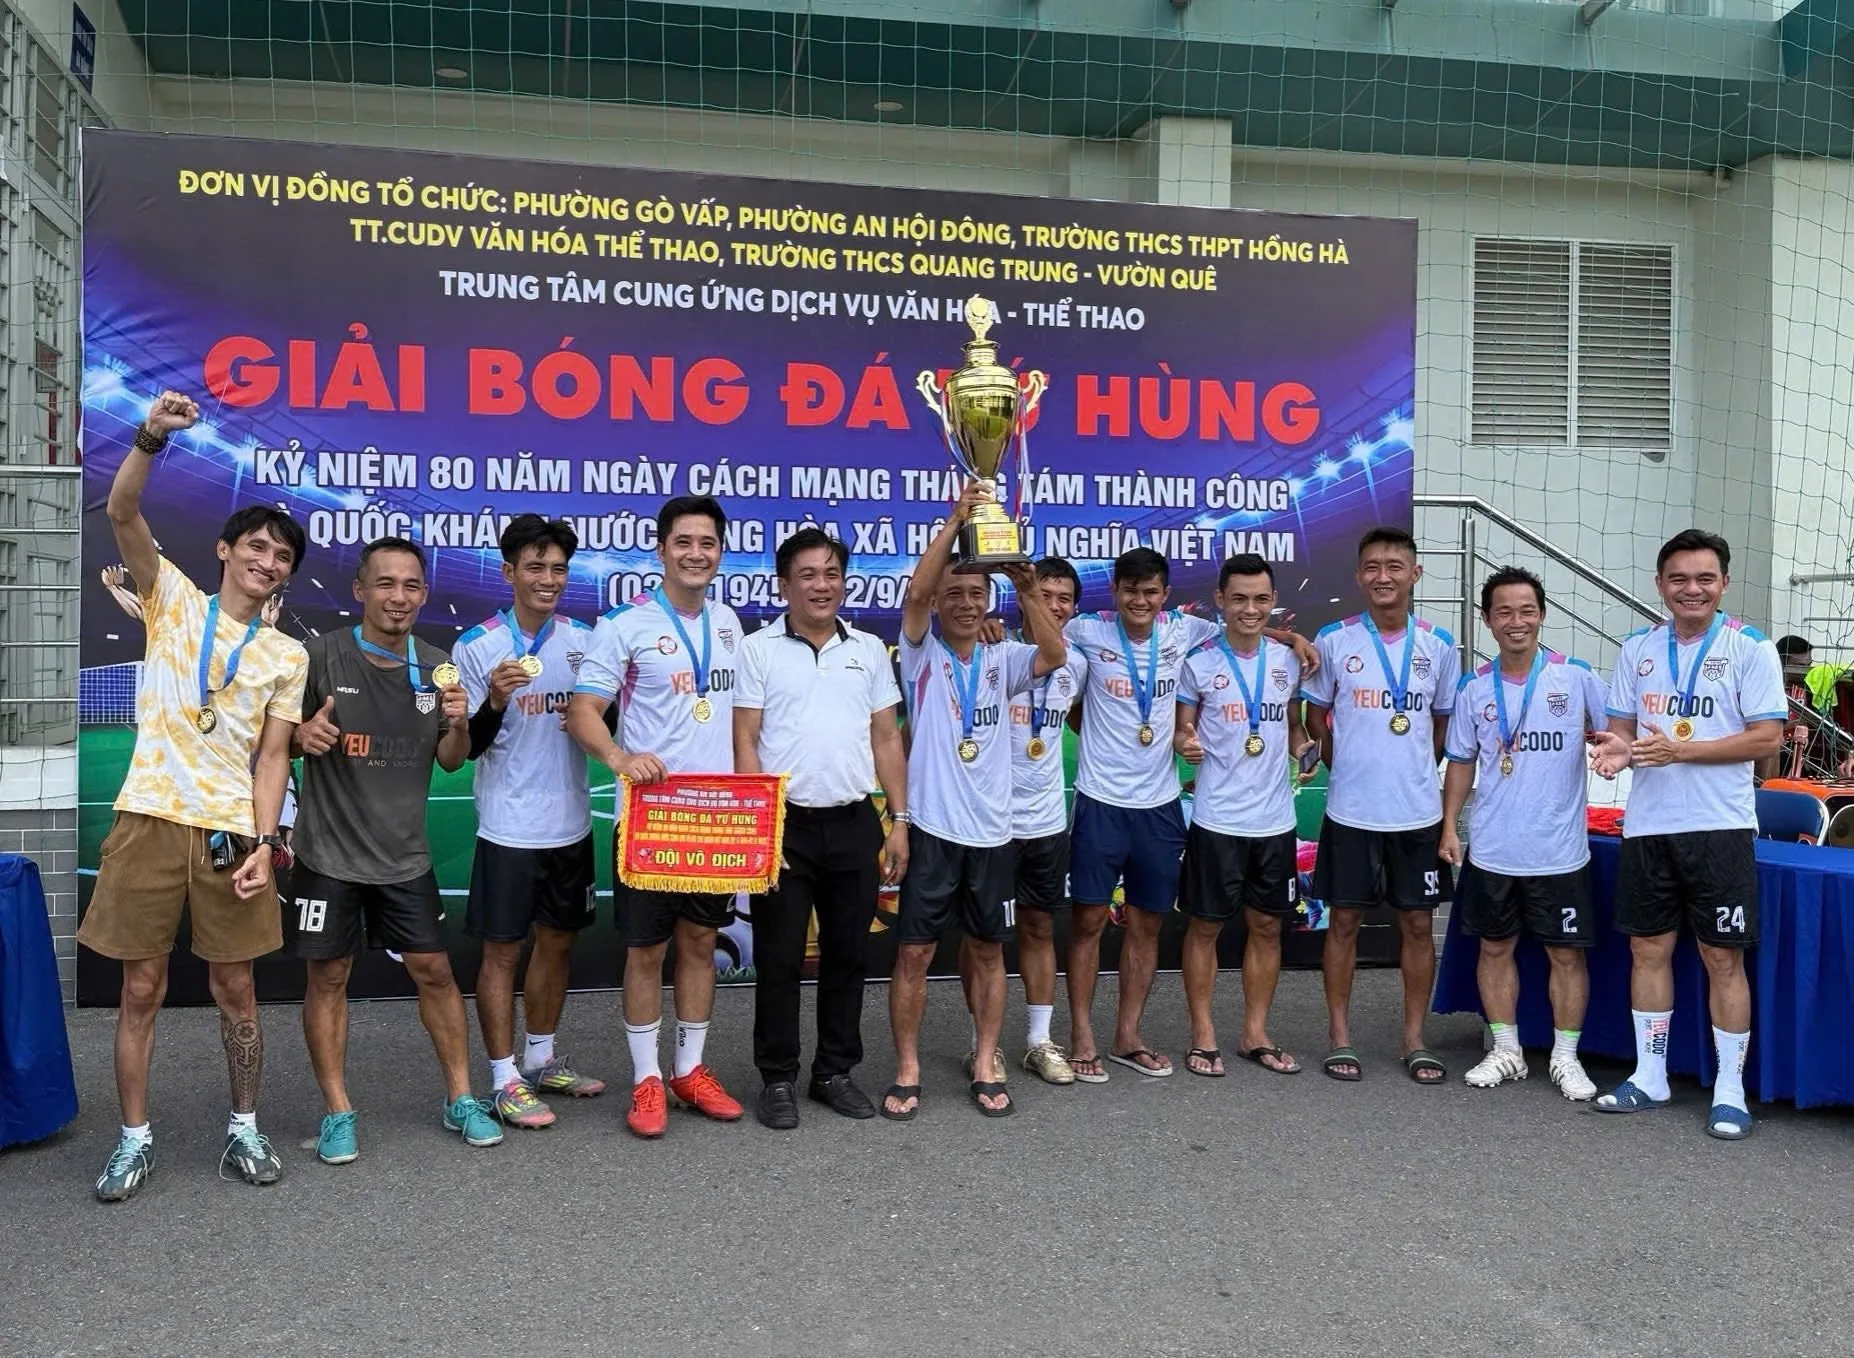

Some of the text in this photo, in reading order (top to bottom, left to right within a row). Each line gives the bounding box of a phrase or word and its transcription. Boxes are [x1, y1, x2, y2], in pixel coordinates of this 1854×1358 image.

[179, 170, 1350, 265] ĐƠN VỊ ĐỒNG TỔ CHỨC: PHƯỜNG GÒ VẤP, PHƯỜNG AN HỘI ĐÔNG, TRƯỜNG THCS THPT HỒNG HÀ
[350, 218, 464, 248] TT.CUDV
[470, 221, 524, 252] VĂN
[532, 225, 589, 256] HÓA
[595, 229, 645, 259] THỂ
[650, 237, 725, 268] THAO,
[731, 239, 837, 271] TRƯỜNG
[843, 249, 904, 275] THCS
[910, 253, 995, 280] QUANG
[1001, 258, 1078, 284] TRUNG
[1097, 260, 1165, 289] VƯỜN
[1171, 265, 1217, 291] QUÊ
[439, 270, 539, 301] TRUNG
[546, 270, 606, 304] TÂM
[613, 280, 694, 309] CUNG
[701, 278, 764, 313] ỨNG
[771, 290, 837, 322] DỊCH
[844, 293, 880, 326] VỤ
[886, 289, 939, 321] VĂN
[946, 294, 1002, 324] HA
[1023, 296, 1073, 327] THỂ
[1076, 304, 1145, 331] THAO
[203, 322, 426, 413] GIẢI
[469, 336, 750, 425] BÓNG
[779, 351, 911, 430] ĐÁ
[1076, 362, 1321, 445] HÙNG
[255, 439, 306, 486] KỶ
[317, 447, 417, 495] NIỆM
[429, 455, 474, 491] 80
[487, 452, 571, 493] NĂM
[583, 456, 678, 495] NGÀY
[688, 457, 779, 497] CÁCH
[791, 466, 891, 506] MẠNG
[1018, 467, 1084, 505] TÁM
[1094, 470, 1196, 508] THÀNH
[1206, 473, 1290, 511] CÔNG
[308, 500, 413, 547] QUỐC
[423, 507, 522, 548] KHÁ
[852, 517, 897, 554] XÃ
[1045, 522, 1140, 559] NGHĨA
[1151, 524, 1216, 567] VIỆT
[1224, 530, 1294, 562] NAM
[1222, 702, 1284, 723] YEUODO
[655, 848, 680, 868] ĐỘI
[712, 853, 747, 869] ĐỊCH
[1561, 907, 1578, 933] 2
[1716, 905, 1746, 933] 24
